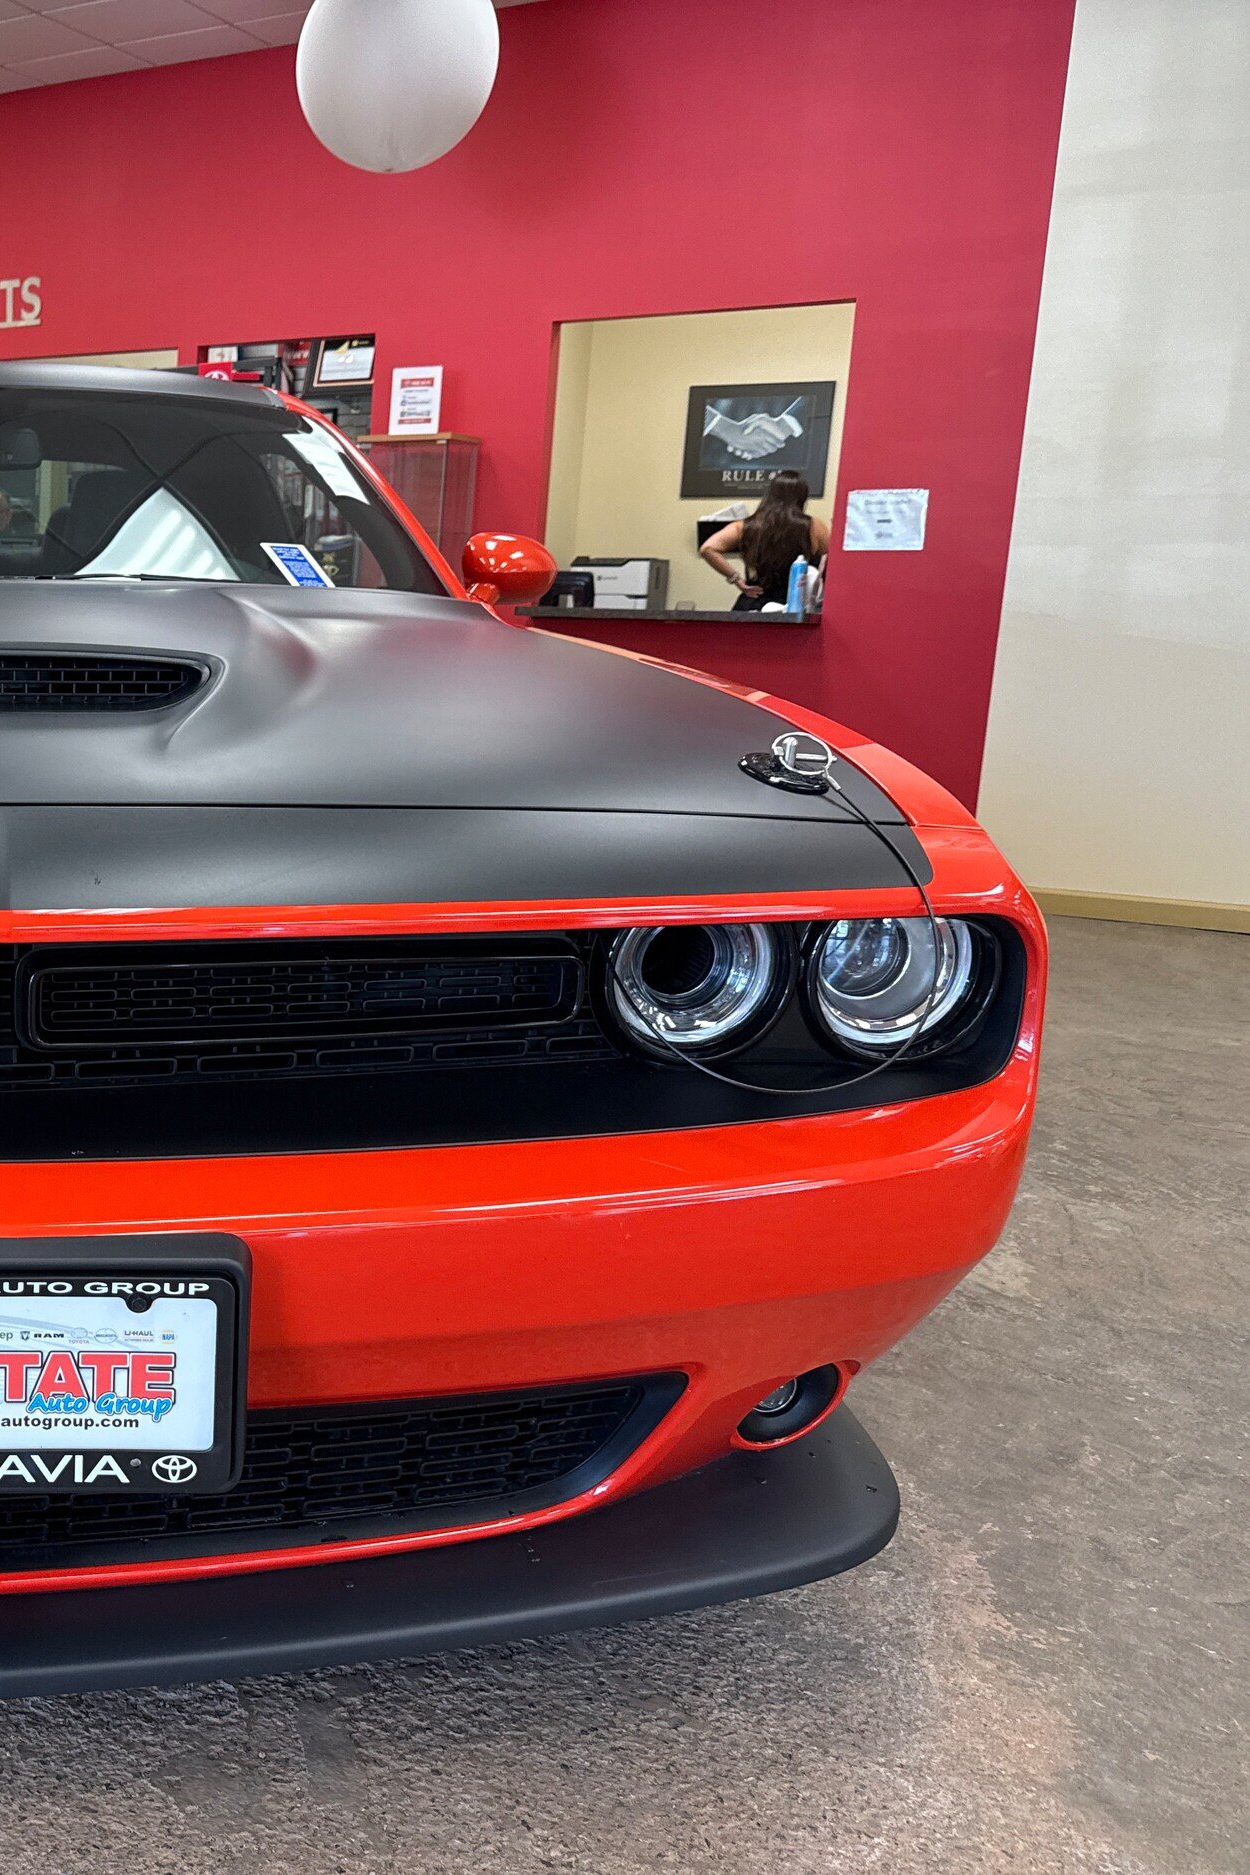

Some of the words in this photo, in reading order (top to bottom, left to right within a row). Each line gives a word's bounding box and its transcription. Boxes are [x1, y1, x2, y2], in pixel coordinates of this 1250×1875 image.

[721, 469, 765, 481] RULE
[84, 1281, 210, 1296] GROUP
[26, 1393, 88, 1414] Auto
[95, 1393, 173, 1422] Group
